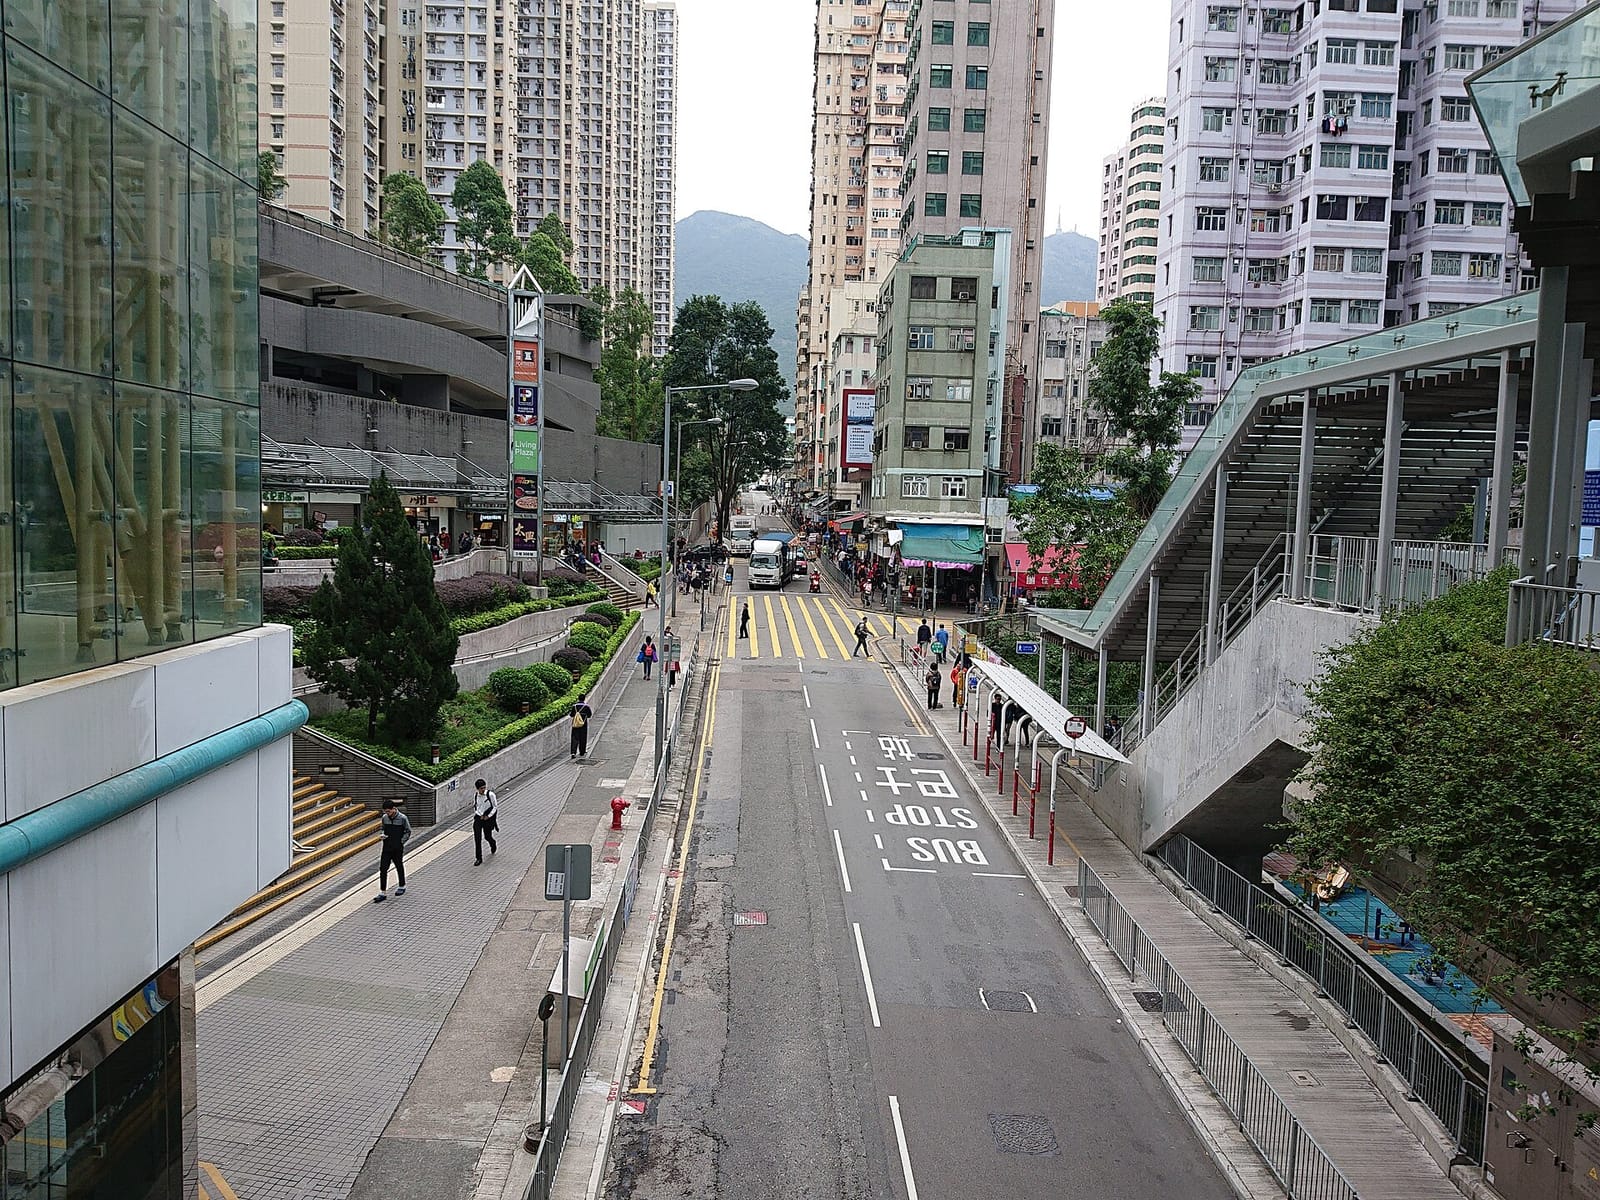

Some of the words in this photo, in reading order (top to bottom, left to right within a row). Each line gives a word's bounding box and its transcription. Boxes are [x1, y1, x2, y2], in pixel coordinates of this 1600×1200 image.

[515, 440, 537, 450] Living
[515, 448, 534, 457] Plaza
[876, 766, 960, 799] 巴士
[885, 804, 979, 829] STOP
[906, 837, 990, 866] BUS
